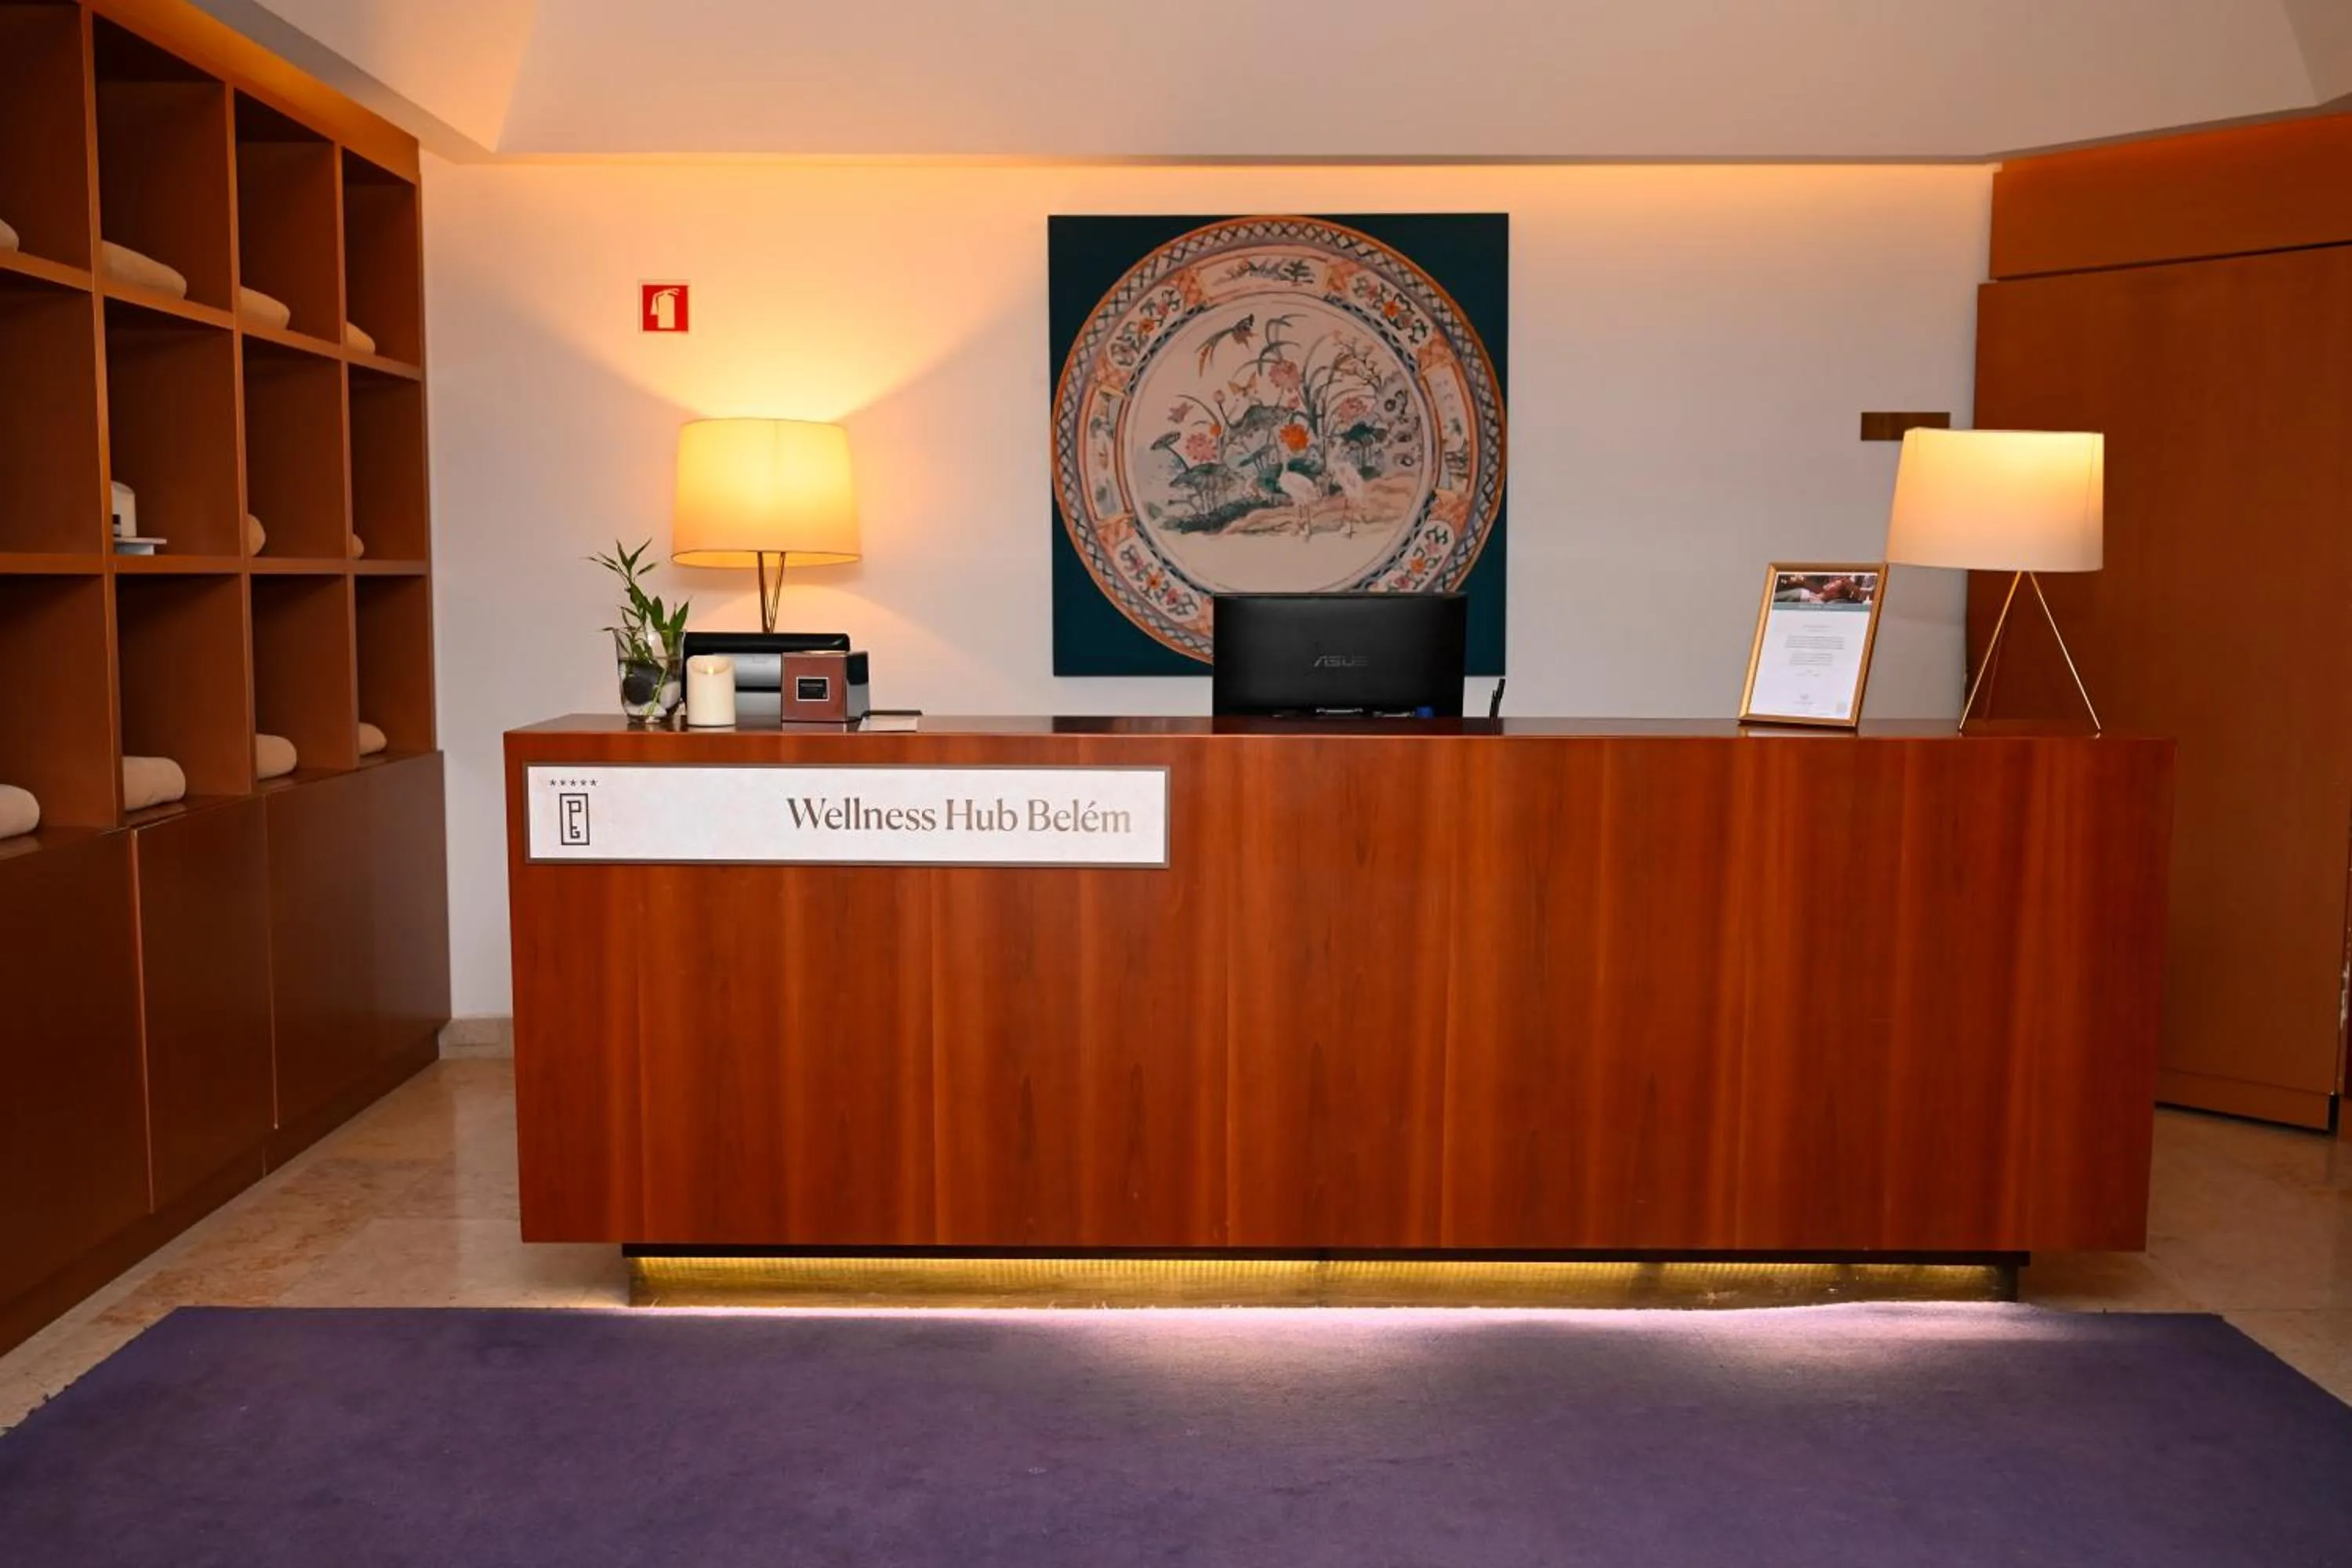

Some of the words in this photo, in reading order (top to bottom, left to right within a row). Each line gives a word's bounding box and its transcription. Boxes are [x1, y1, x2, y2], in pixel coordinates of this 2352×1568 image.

[1314, 655, 1370, 667] ASUS
[786, 797, 937, 831] Wellness
[946, 798, 1018, 832] Hub
[1027, 798, 1131, 833] Belém
